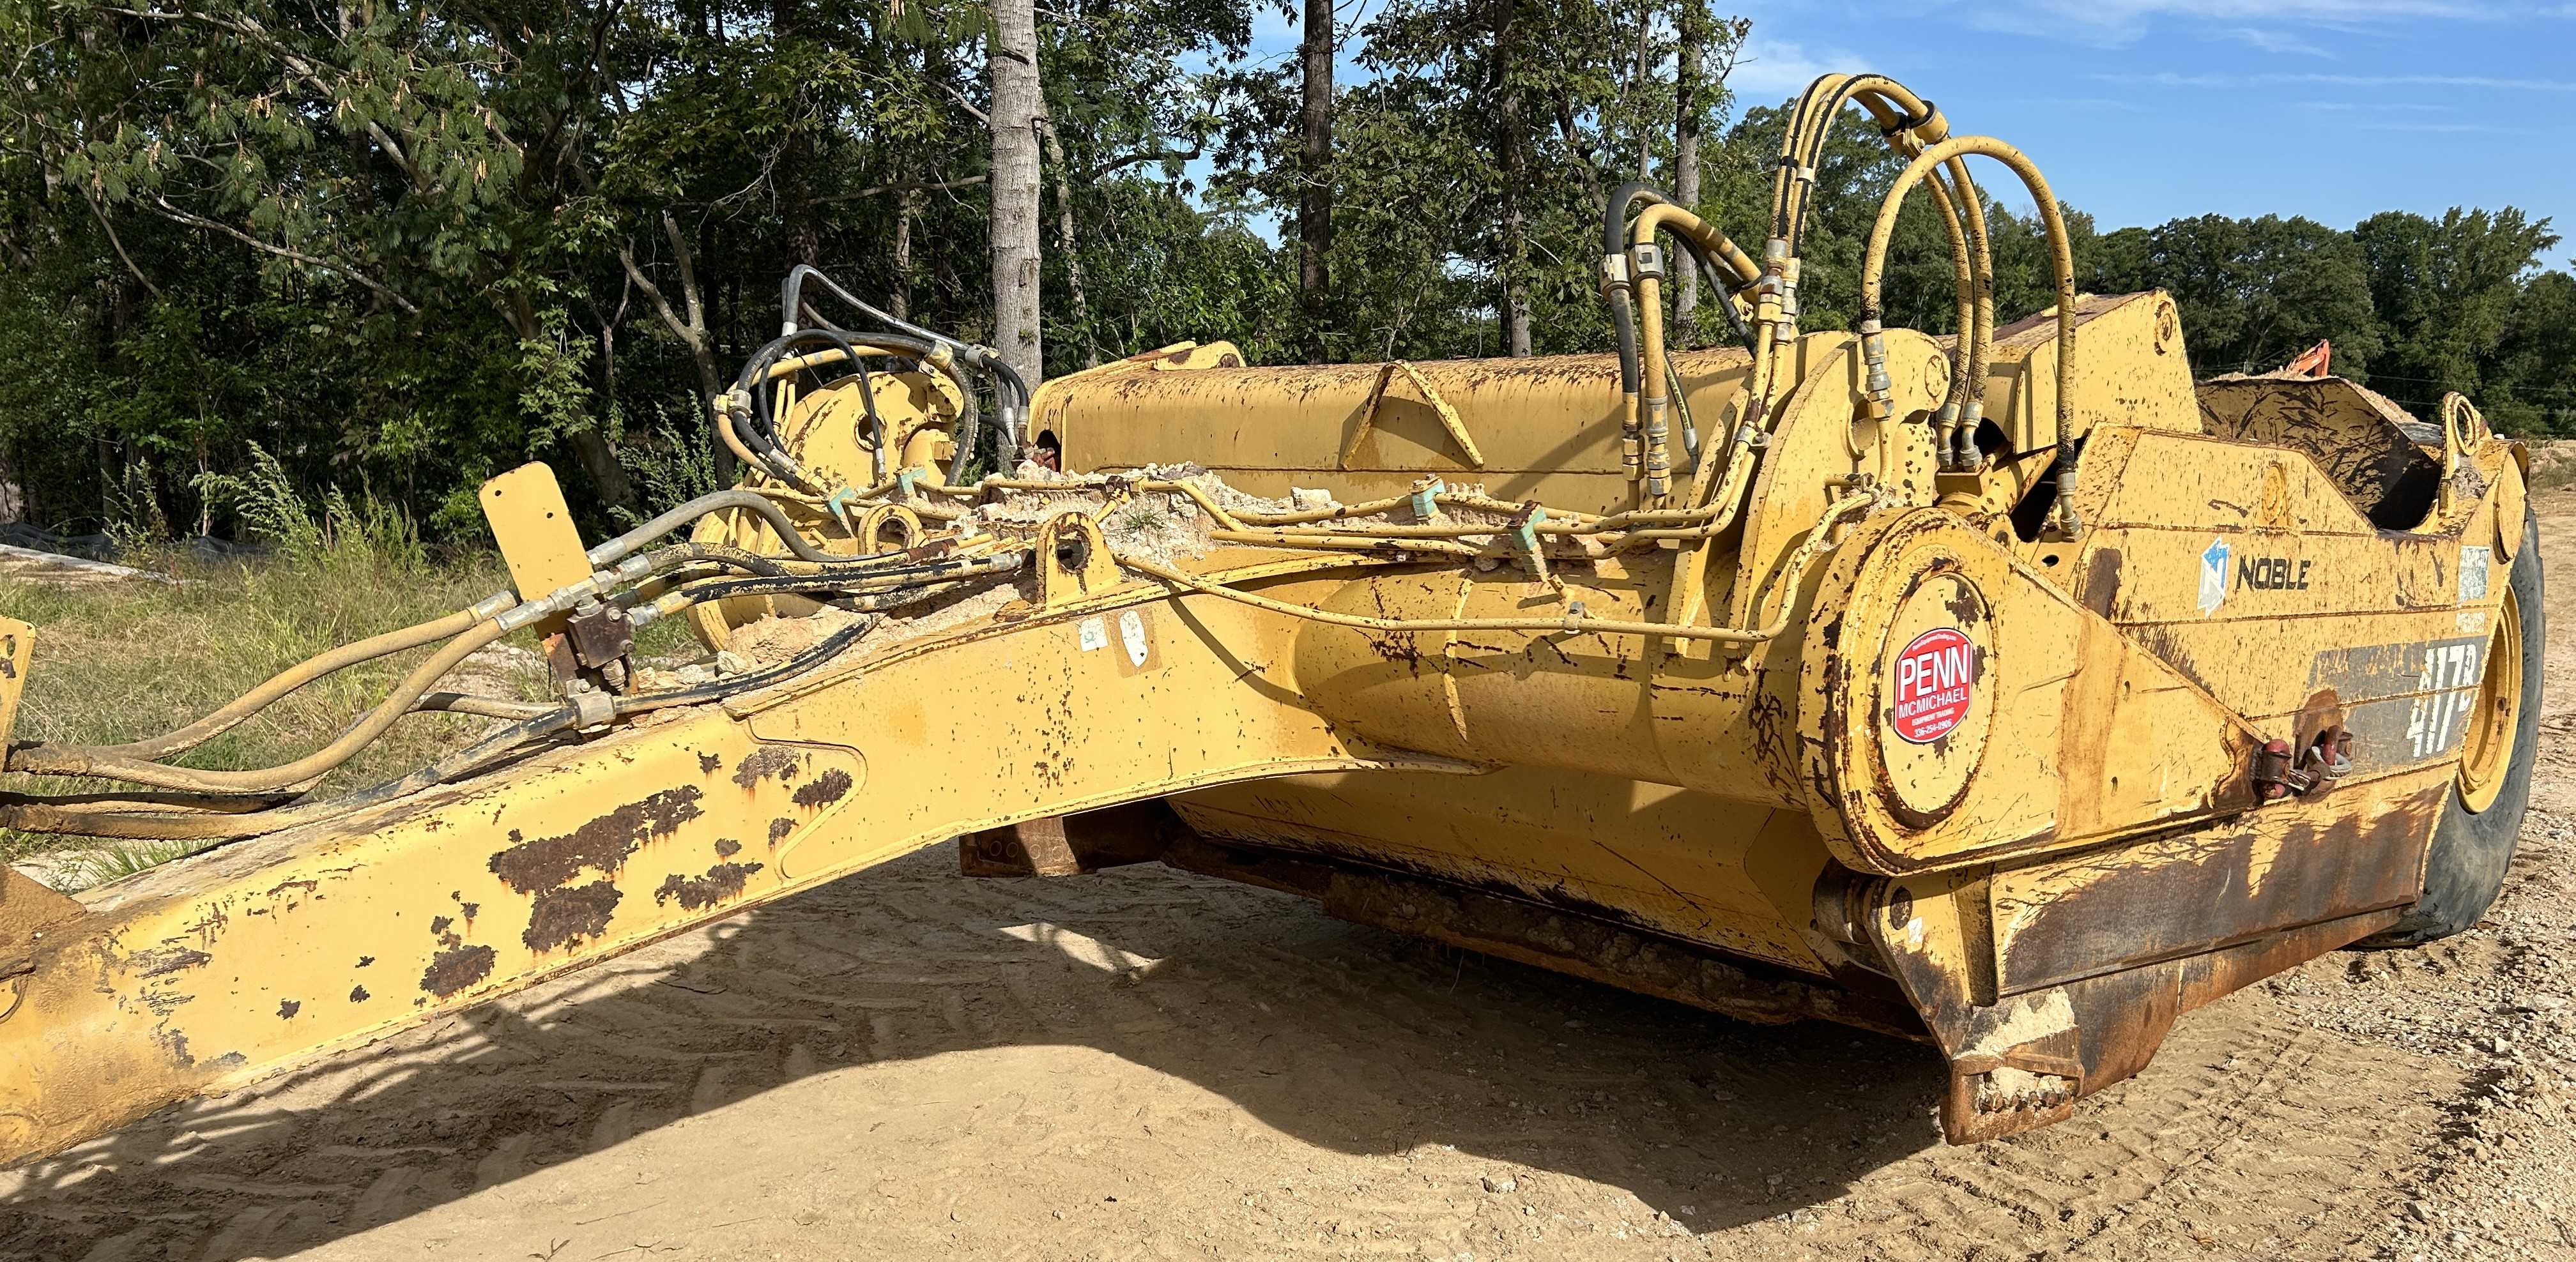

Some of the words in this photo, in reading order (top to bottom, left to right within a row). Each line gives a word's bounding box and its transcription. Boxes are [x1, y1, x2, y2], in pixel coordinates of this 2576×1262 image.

[2235, 555, 2311, 591] NOBLE
[1899, 643, 1968, 701] PENN
[1898, 687, 1968, 719] MCMICHAEL
[1912, 713, 1936, 726] EQUIPMENT
[1936, 707, 1955, 719] TRADING
